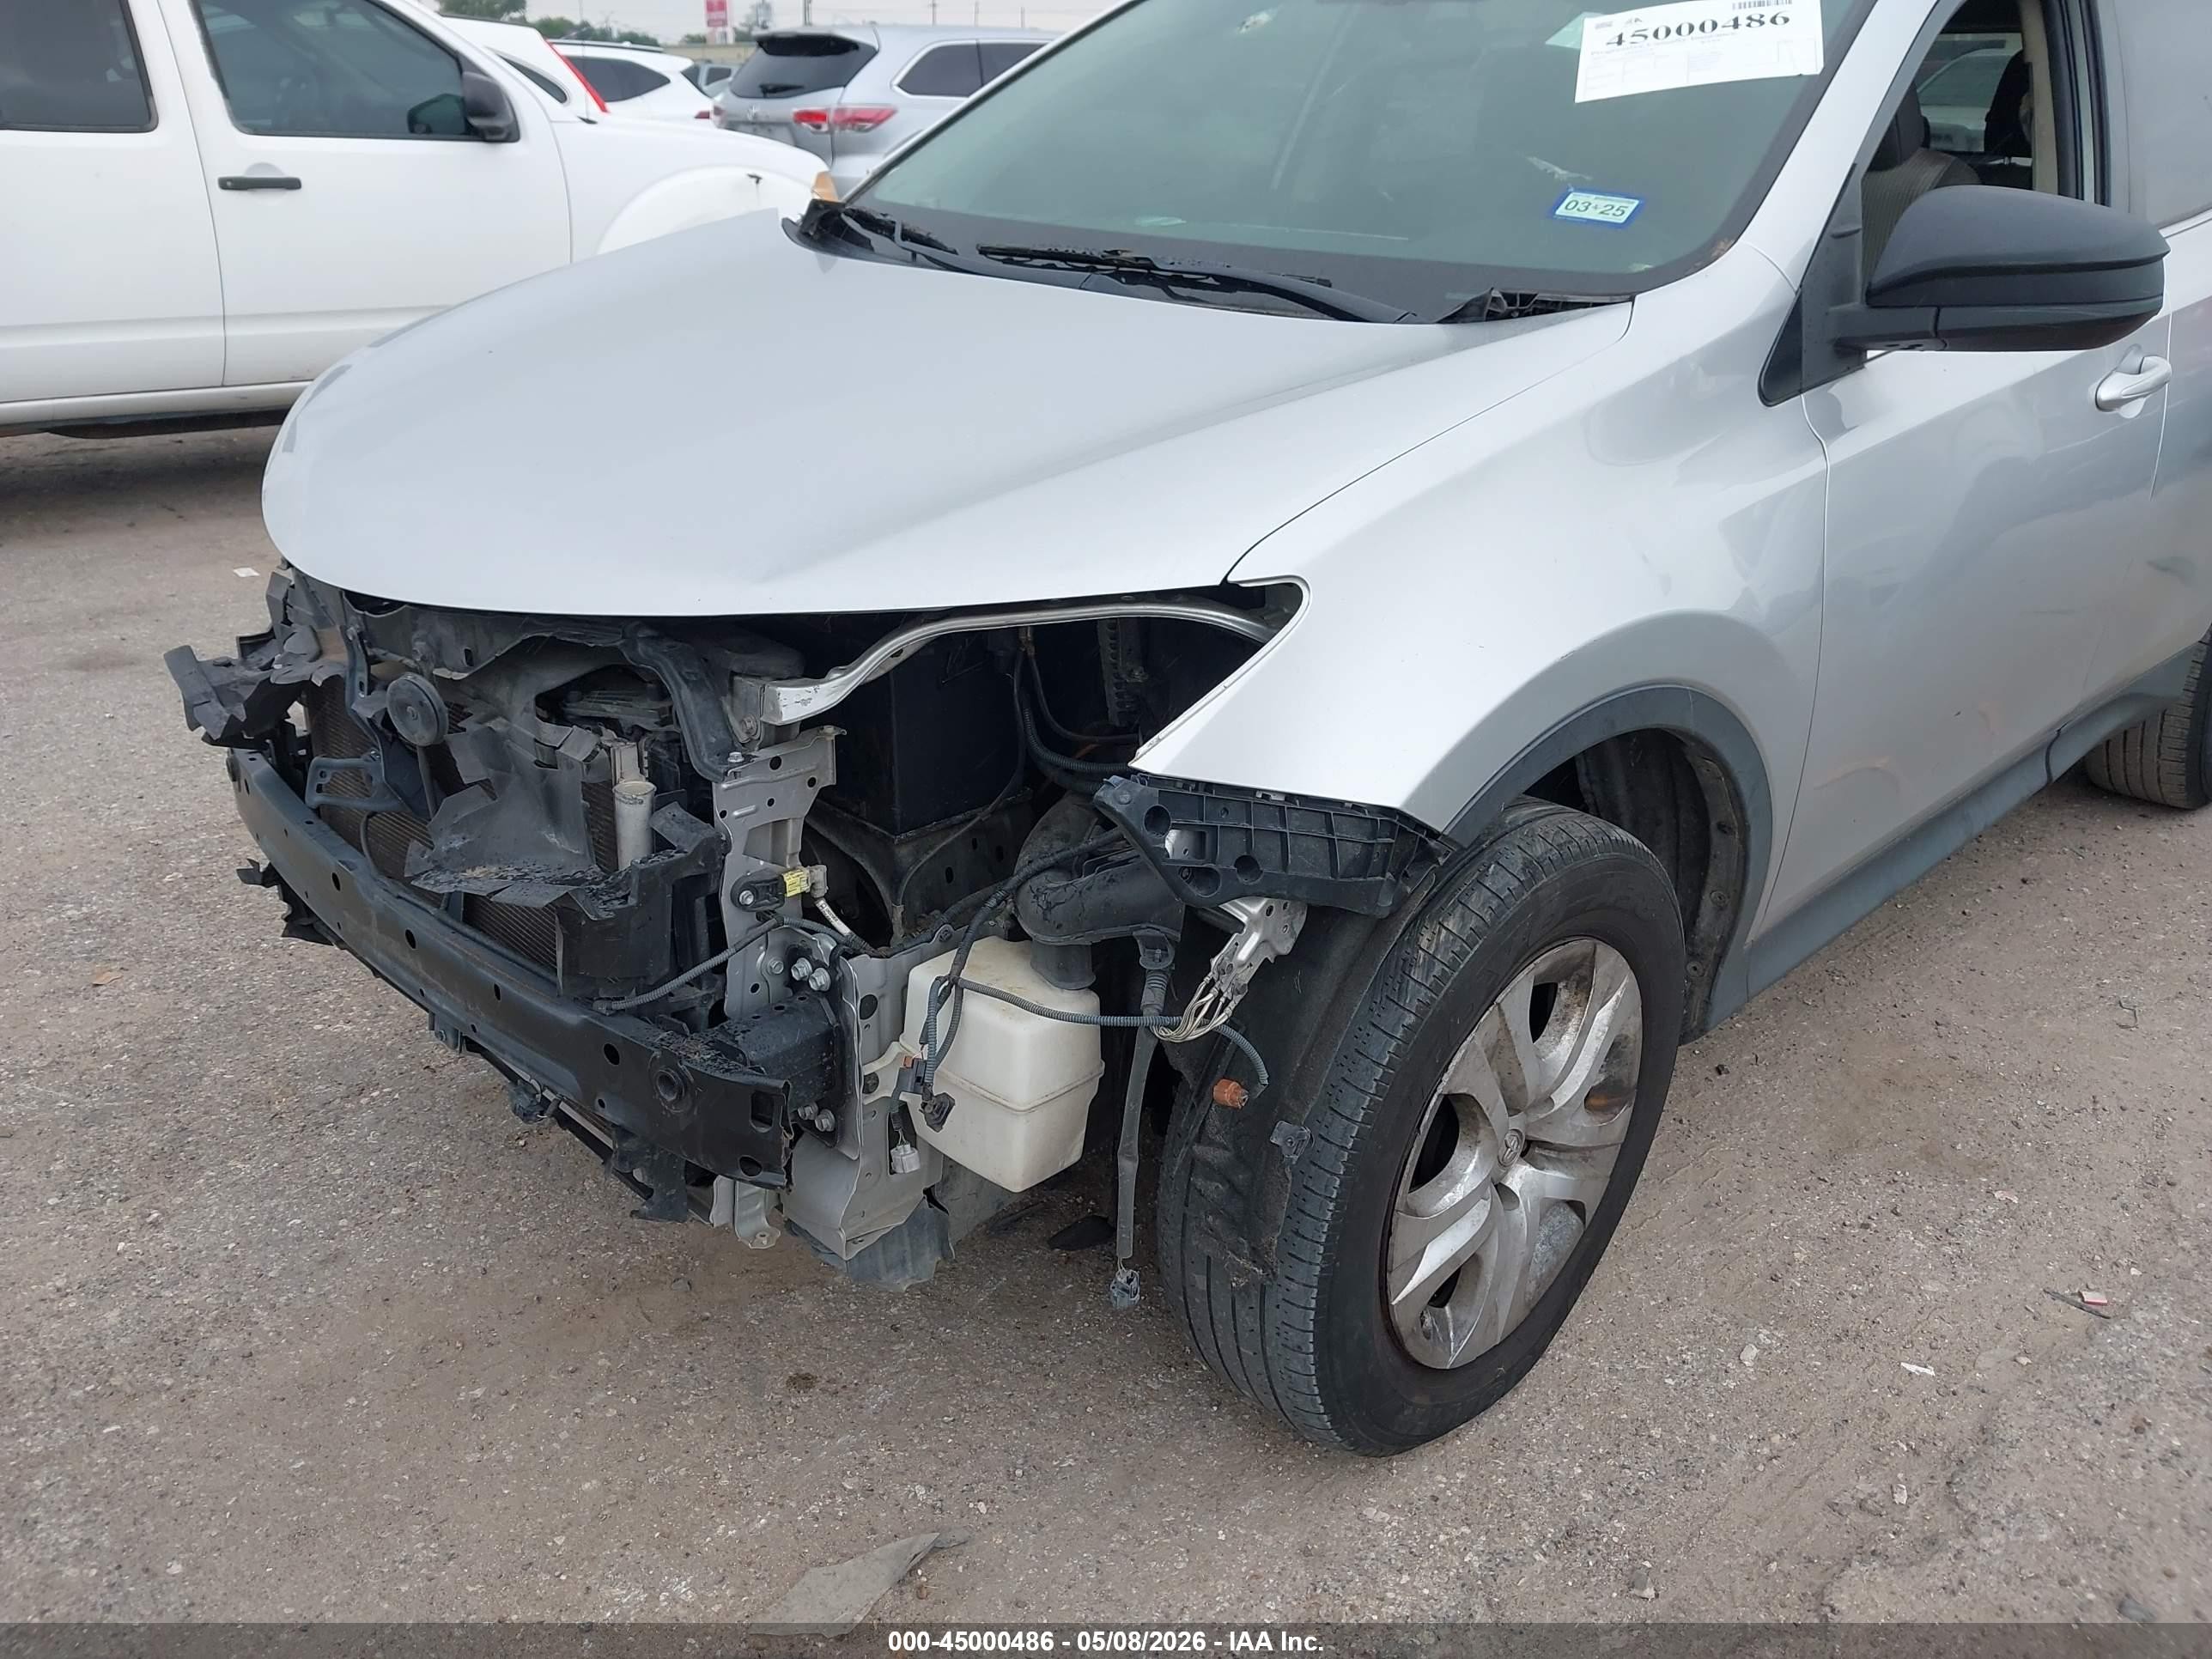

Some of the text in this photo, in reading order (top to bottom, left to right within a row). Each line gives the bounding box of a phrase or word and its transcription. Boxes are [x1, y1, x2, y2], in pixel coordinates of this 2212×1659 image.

[1606, 11, 1790, 46] 45000486
[1565, 199, 1629, 216] 03 25
